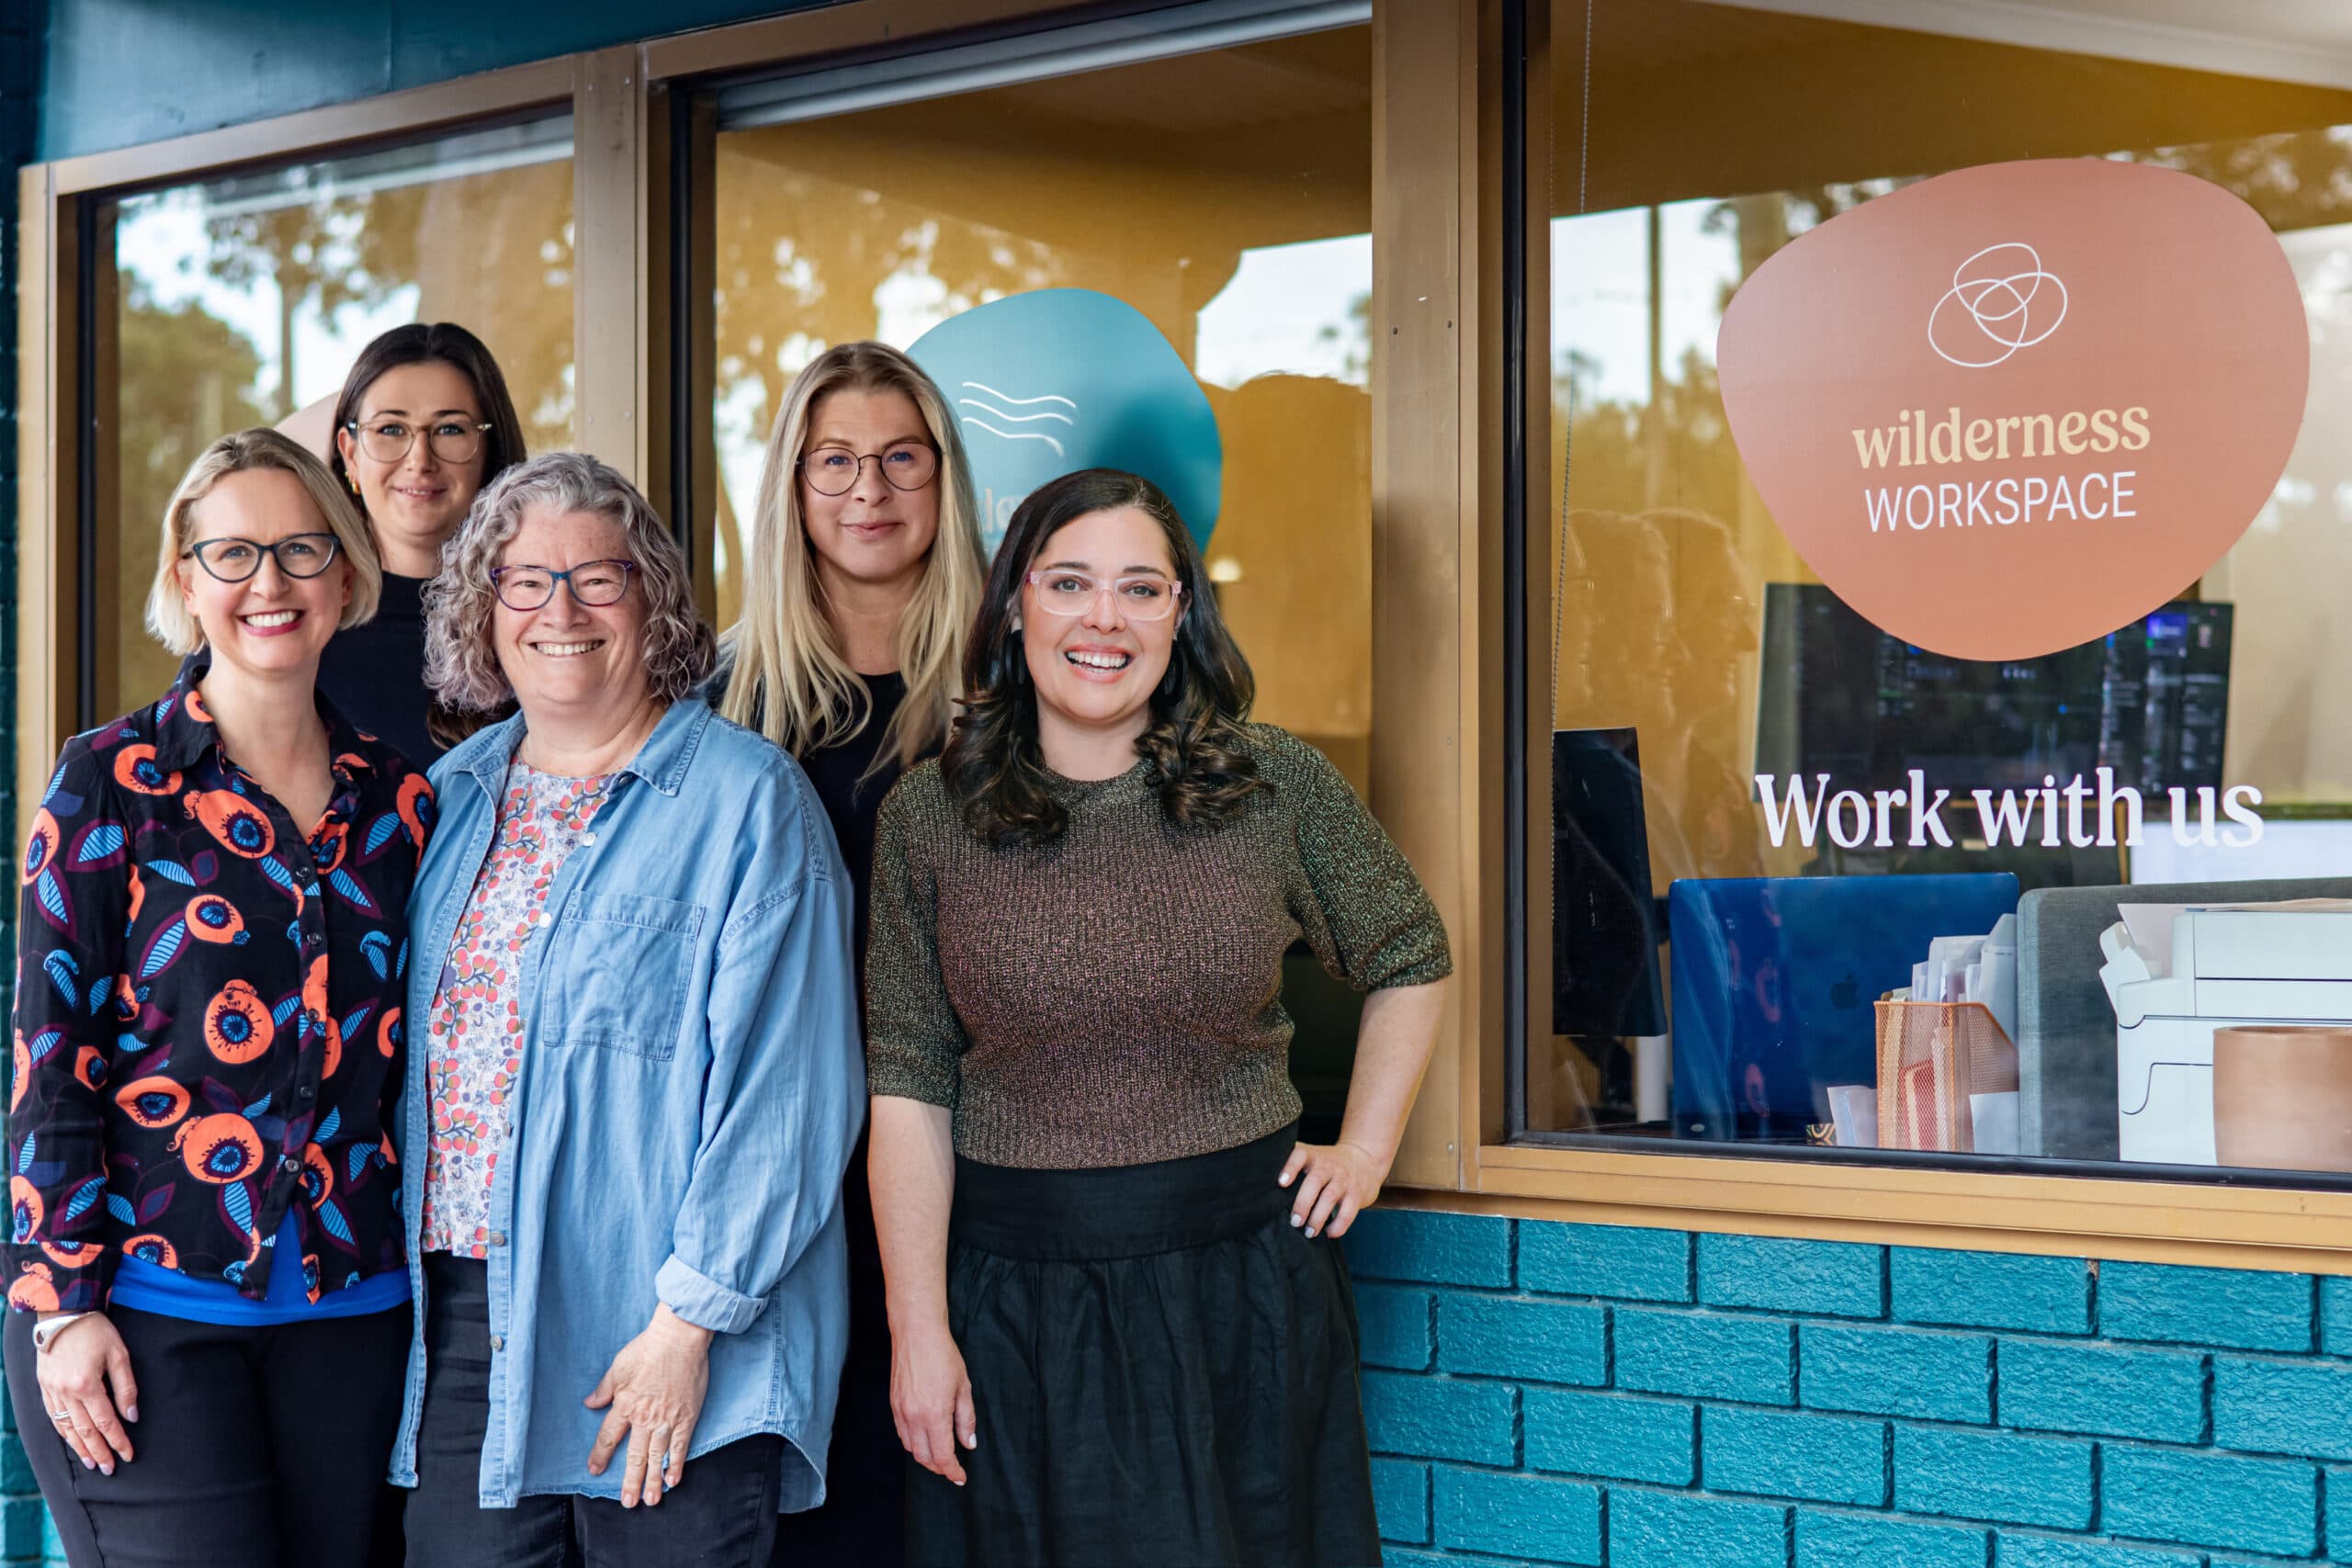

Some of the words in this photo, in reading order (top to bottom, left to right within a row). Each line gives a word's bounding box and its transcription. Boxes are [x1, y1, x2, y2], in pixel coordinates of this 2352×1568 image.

[1851, 407, 2151, 469] wilderness
[1864, 470, 2137, 533] WORKSPACE
[1755, 769, 1953, 848] Work
[1972, 767, 2145, 848] with
[2168, 784, 2265, 848] us
